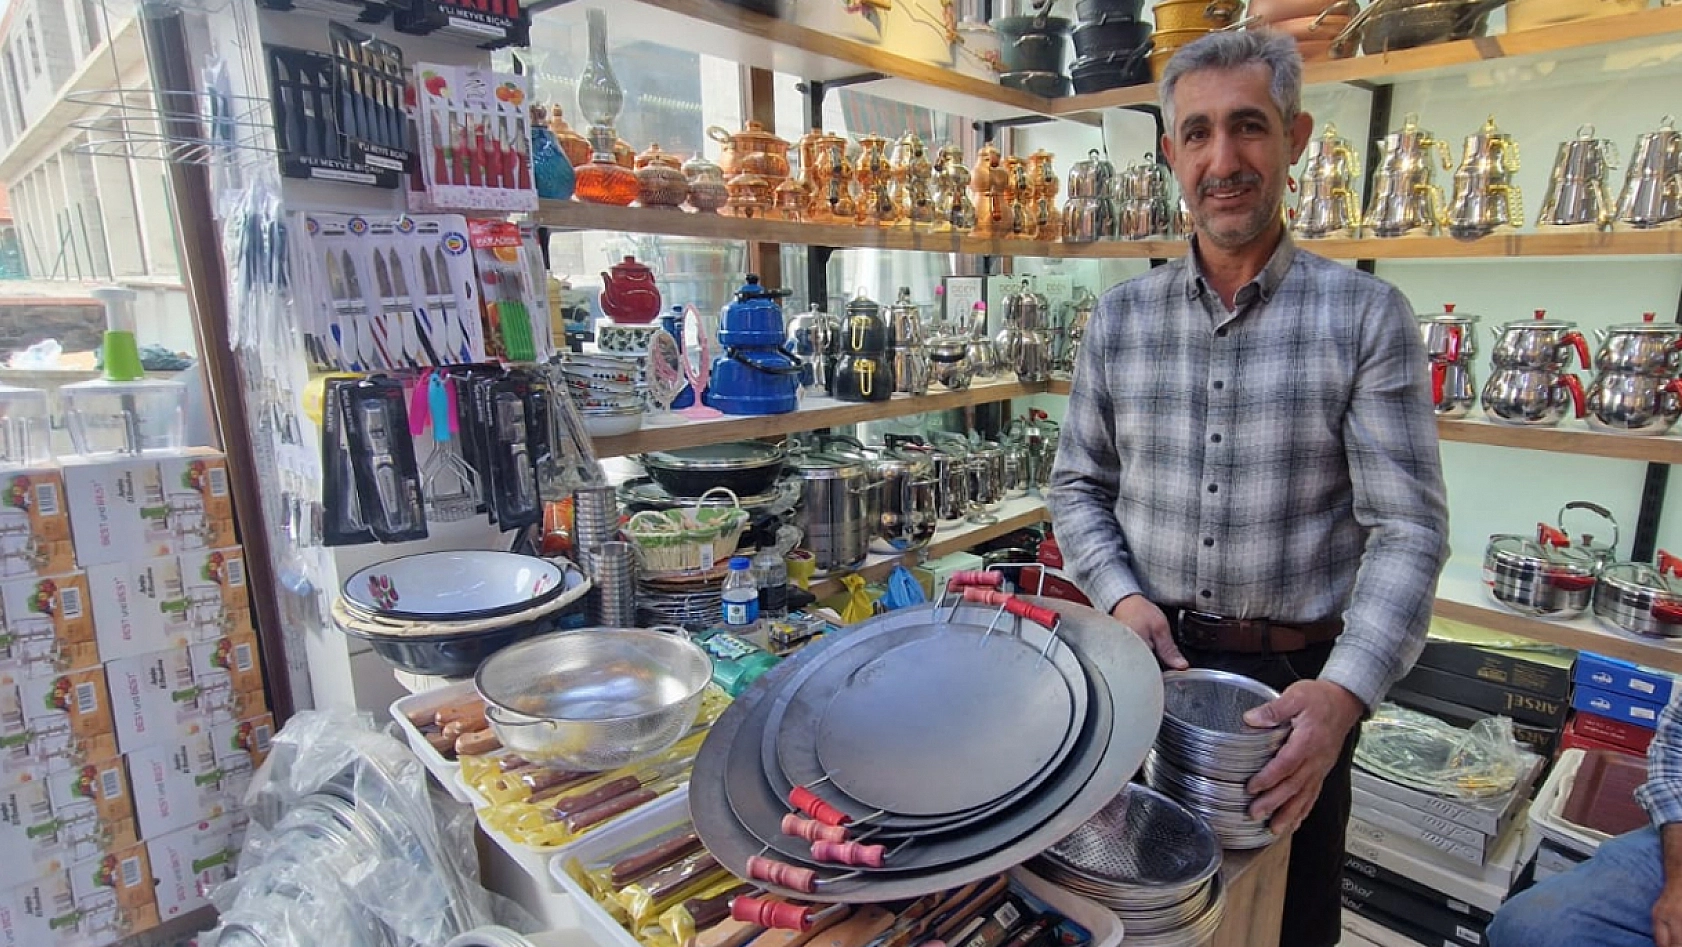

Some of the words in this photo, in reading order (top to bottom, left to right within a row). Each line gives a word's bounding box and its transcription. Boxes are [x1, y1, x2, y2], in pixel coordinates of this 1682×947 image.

[92, 482, 104, 506] BEST
[99, 522, 110, 546] BEST
[115, 579, 126, 602] BEST
[121, 618, 132, 640] BEST
[129, 673, 138, 694] BEST
[135, 711, 144, 732] BEST
